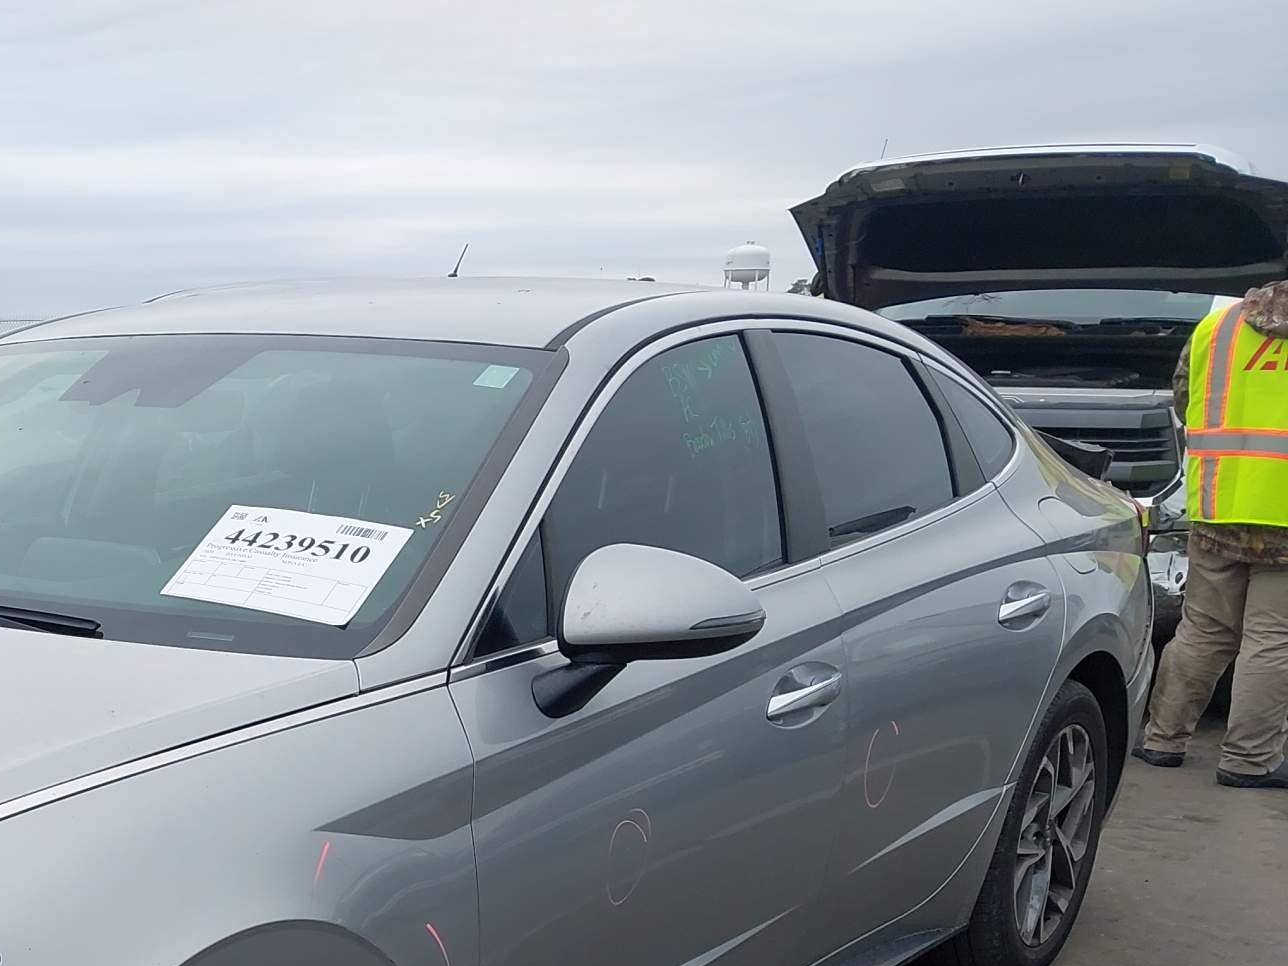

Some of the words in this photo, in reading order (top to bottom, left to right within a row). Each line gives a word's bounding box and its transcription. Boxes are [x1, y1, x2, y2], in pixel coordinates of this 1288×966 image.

[206, 542, 249, 554] Progressive
[248, 547, 281, 558] Casualty
[281, 552, 319, 563] Insurance
[224, 528, 371, 564] 44239510
